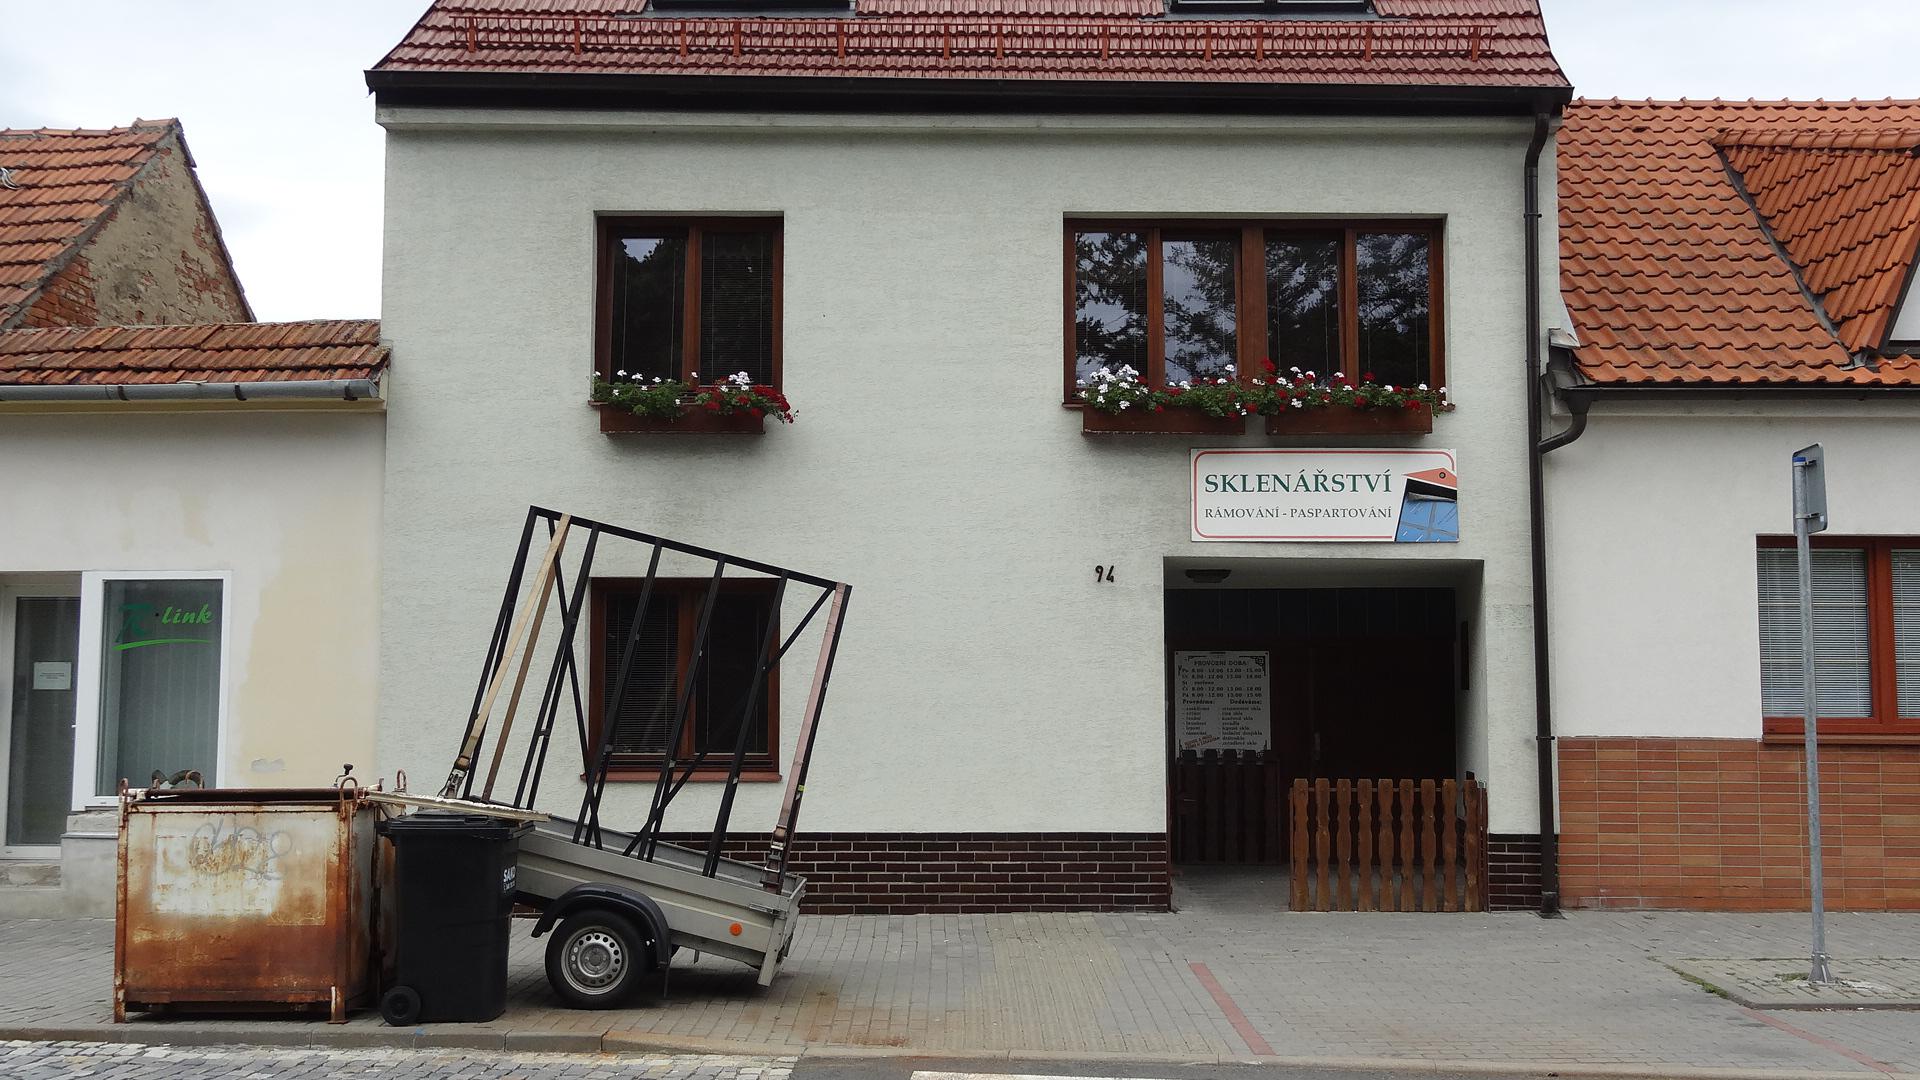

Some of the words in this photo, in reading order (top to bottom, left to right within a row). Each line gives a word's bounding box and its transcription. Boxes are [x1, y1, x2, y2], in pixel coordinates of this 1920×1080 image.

[1204, 468, 1392, 493] SKLENÁŘSTVÍ
[1205, 506, 1279, 519] RÁMOVÁNÍ
[1290, 506, 1392, 519] PASPARTOVÁNÍ
[1095, 564, 1115, 583] 94
